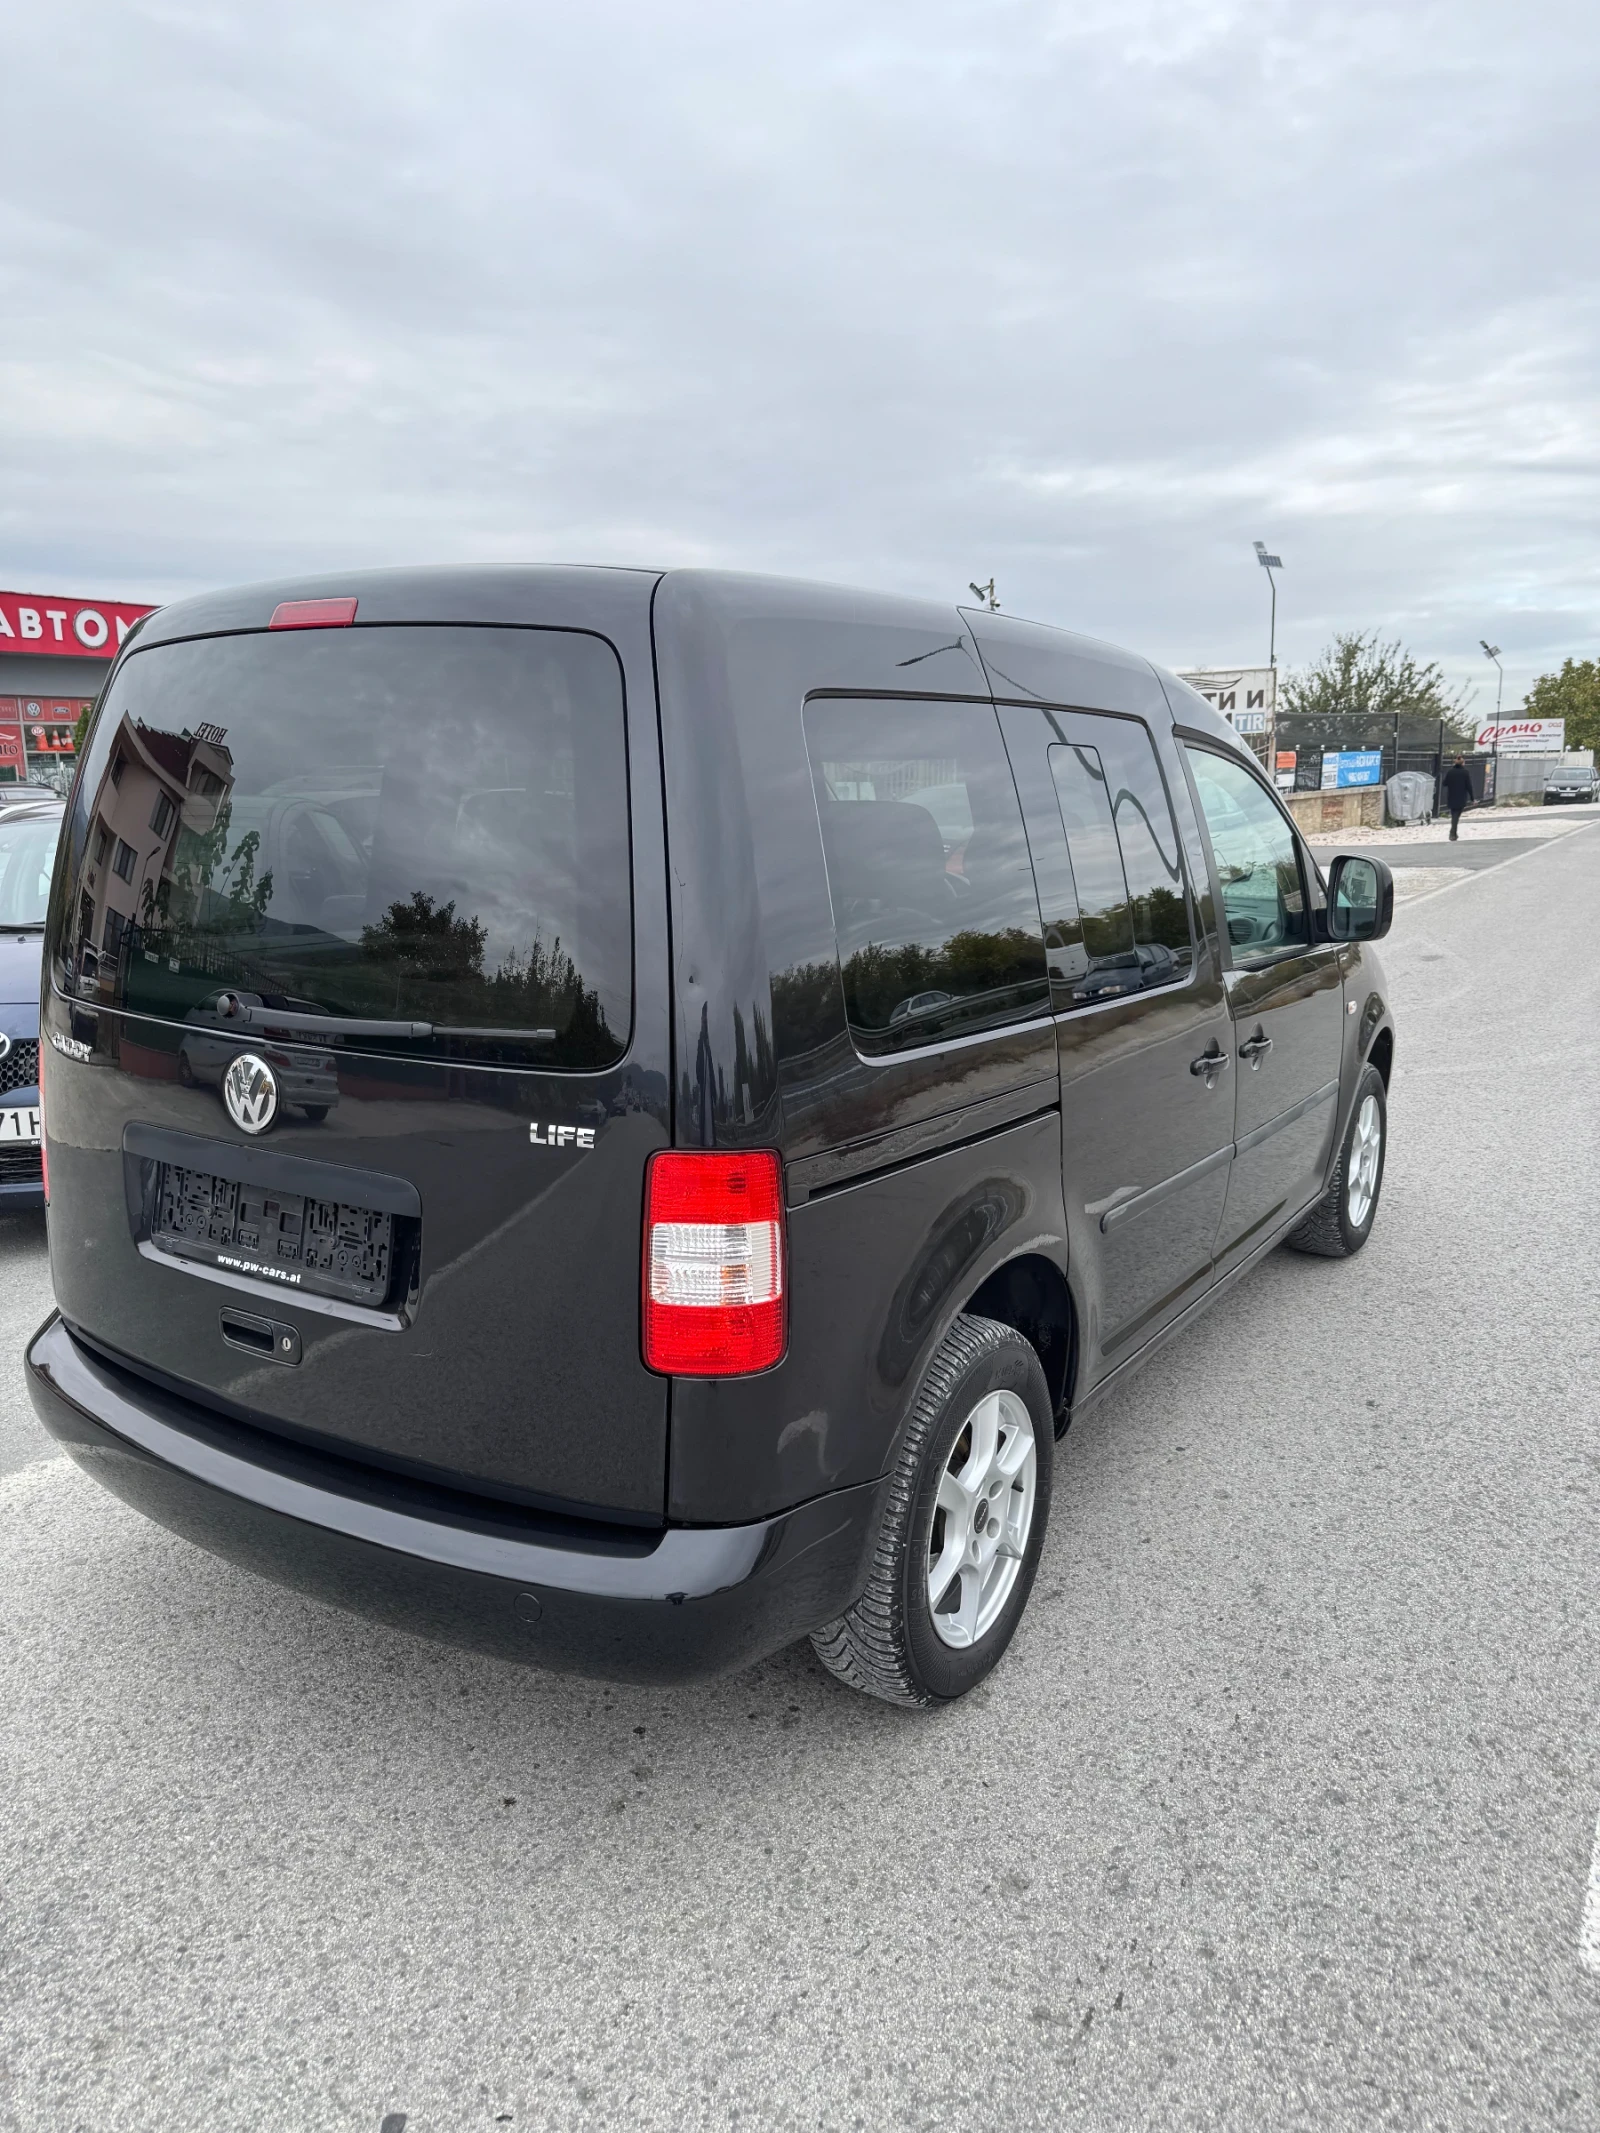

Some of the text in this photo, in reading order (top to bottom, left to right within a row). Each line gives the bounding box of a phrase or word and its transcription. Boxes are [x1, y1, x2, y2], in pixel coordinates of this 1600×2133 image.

[1236, 713, 1264, 731] TIR
[52, 1031, 93, 1062] CADDY
[529, 1122, 596, 1149] LIFE
